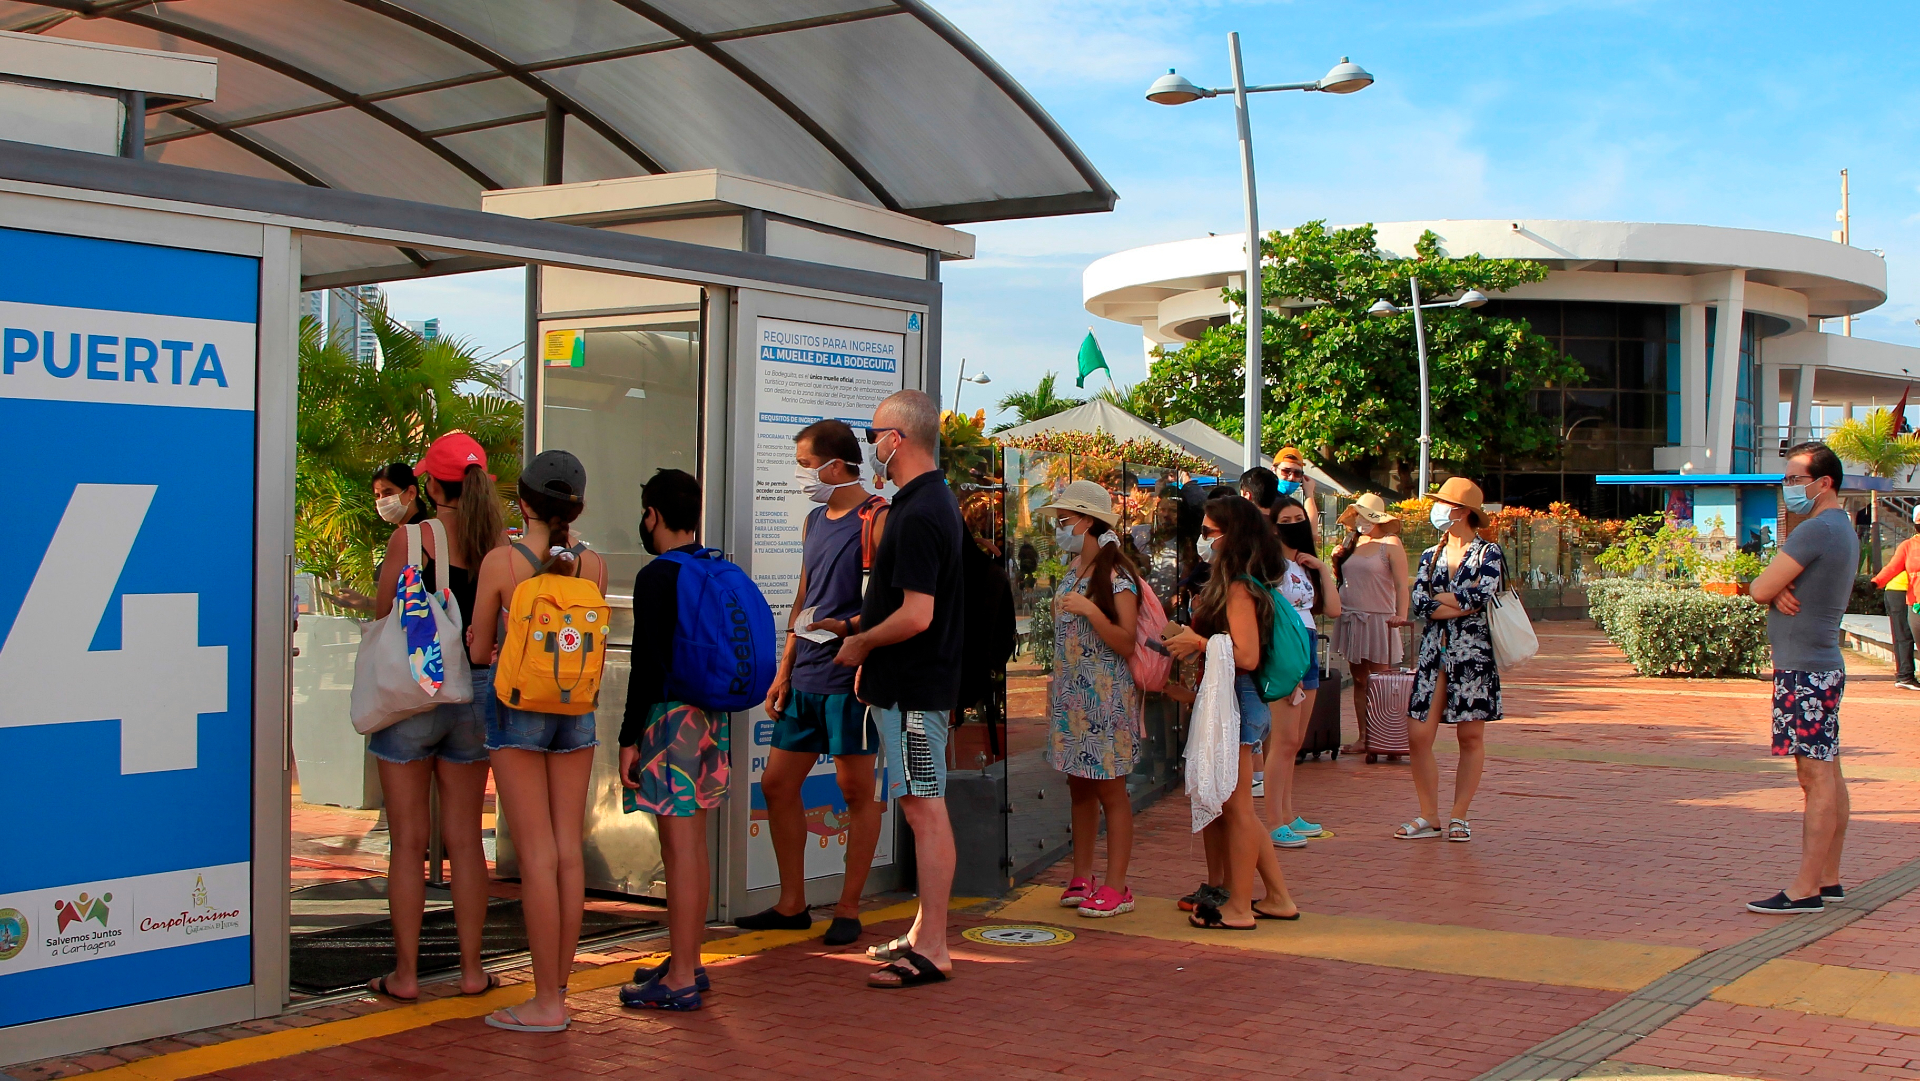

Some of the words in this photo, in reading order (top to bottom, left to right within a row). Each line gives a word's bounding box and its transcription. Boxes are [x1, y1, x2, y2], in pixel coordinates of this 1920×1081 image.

[763, 330, 820, 347] REQUISITOS
[822, 337, 848, 350] PARA
[849, 341, 894, 355] INGRESAR
[3, 327, 229, 389] PUERTA
[762, 347, 776, 359] AL
[776, 349, 815, 363] MUELLE
[815, 353, 829, 365] DE
[830, 355, 843, 366] LA
[843, 357, 895, 371] BODEGUITA
[789, 380, 812, 388] comercial
[823, 382, 838, 390] incluye
[799, 416, 820, 424] INGRESO
[0, 483, 228, 775] 4
[725, 596, 752, 696] Reebok
[752, 826, 757, 834] 6
[140, 909, 240, 932] CorpoTurismo
[46, 933, 90, 947] Salvemos
[92, 928, 122, 940] Juntos
[51, 949, 58, 957] a
[62, 940, 116, 955] Cartagena
